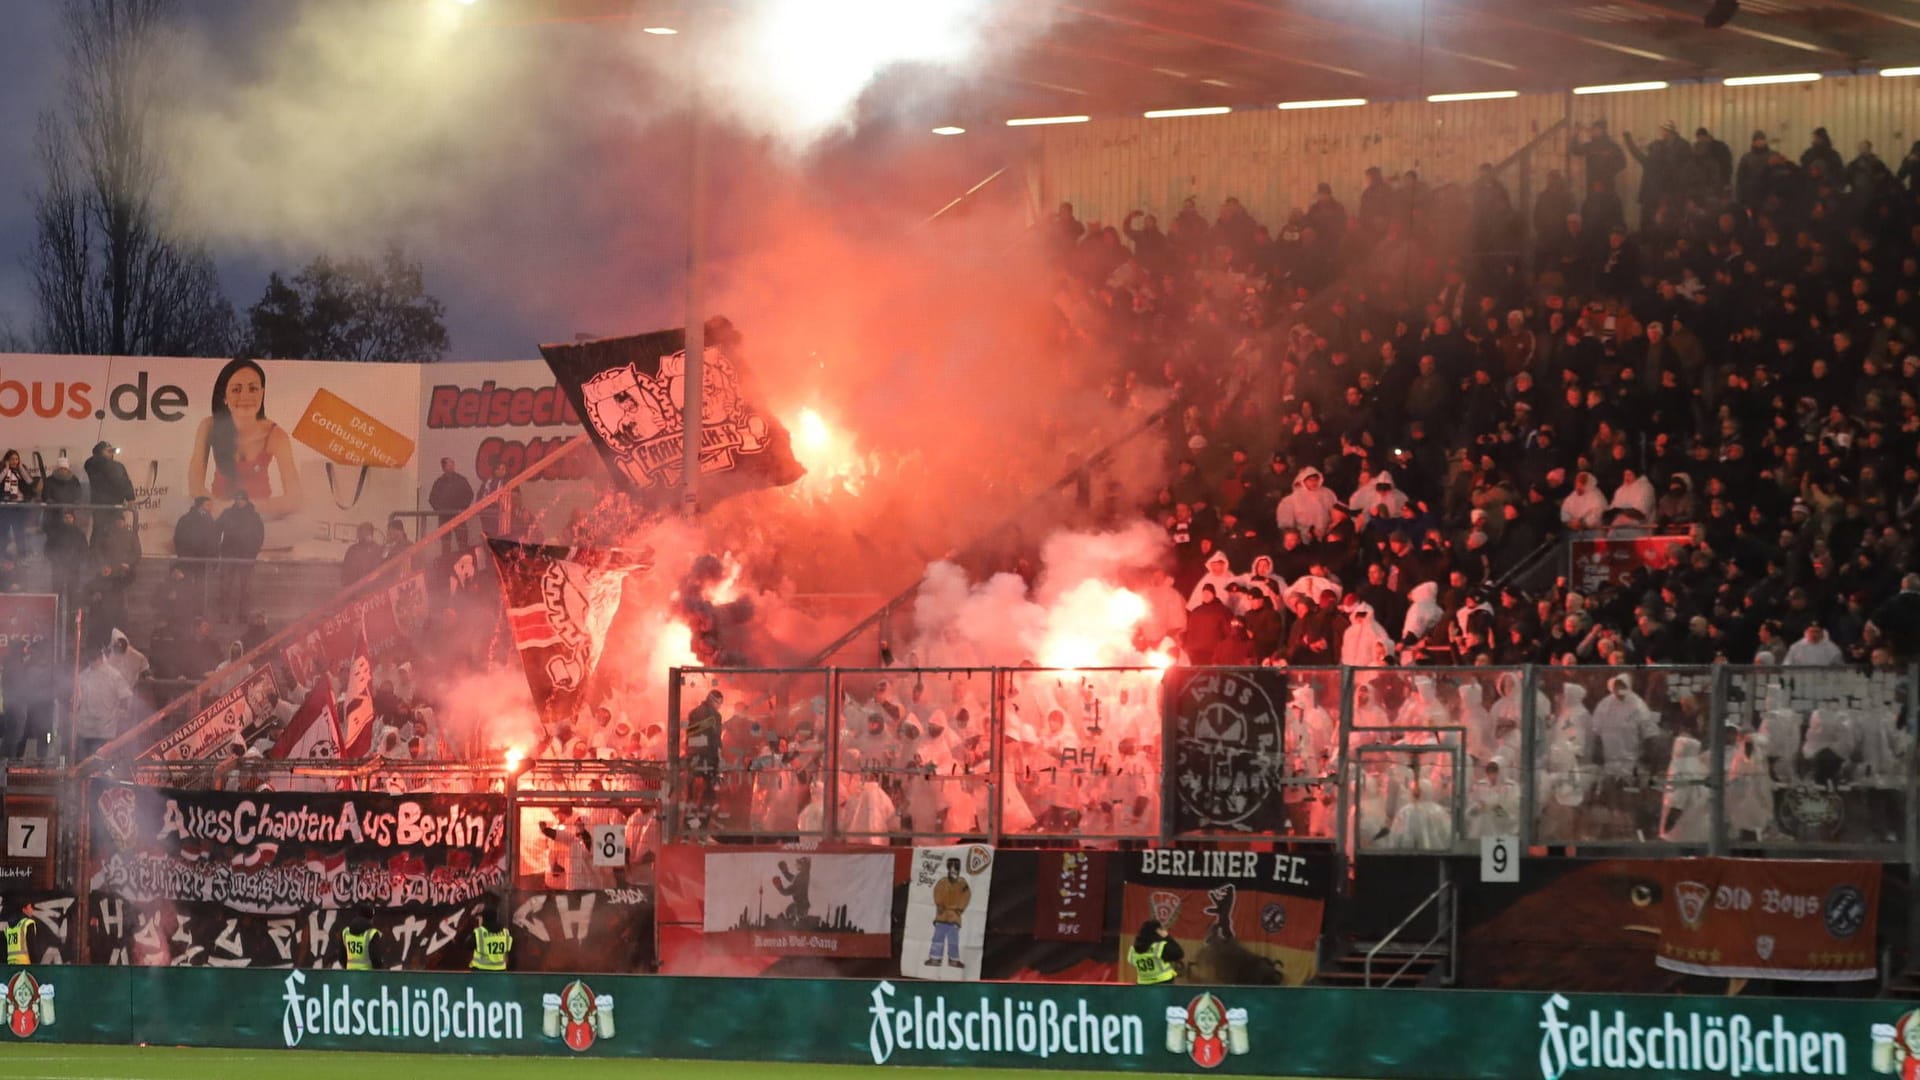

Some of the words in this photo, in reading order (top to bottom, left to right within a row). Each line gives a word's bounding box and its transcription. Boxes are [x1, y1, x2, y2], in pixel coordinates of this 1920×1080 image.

[311, 411, 368, 450] Cottbuser
[349, 416, 375, 437] DAS
[159, 713, 206, 752] DYNAMO
[20, 824, 36, 850] 7
[603, 831, 617, 859] 8
[1141, 848, 1259, 878] BERLINER
[1272, 854, 1310, 887] F.C.
[1492, 844, 1508, 874] 9
[1714, 885, 1753, 912] Old
[1761, 887, 1820, 920] Boys
[486, 940, 505, 955] 129
[282, 968, 524, 1048] Feldschlößchen
[868, 979, 1144, 1066] Feldschlößchen
[1539, 993, 1848, 1080] Feldschlößchen
